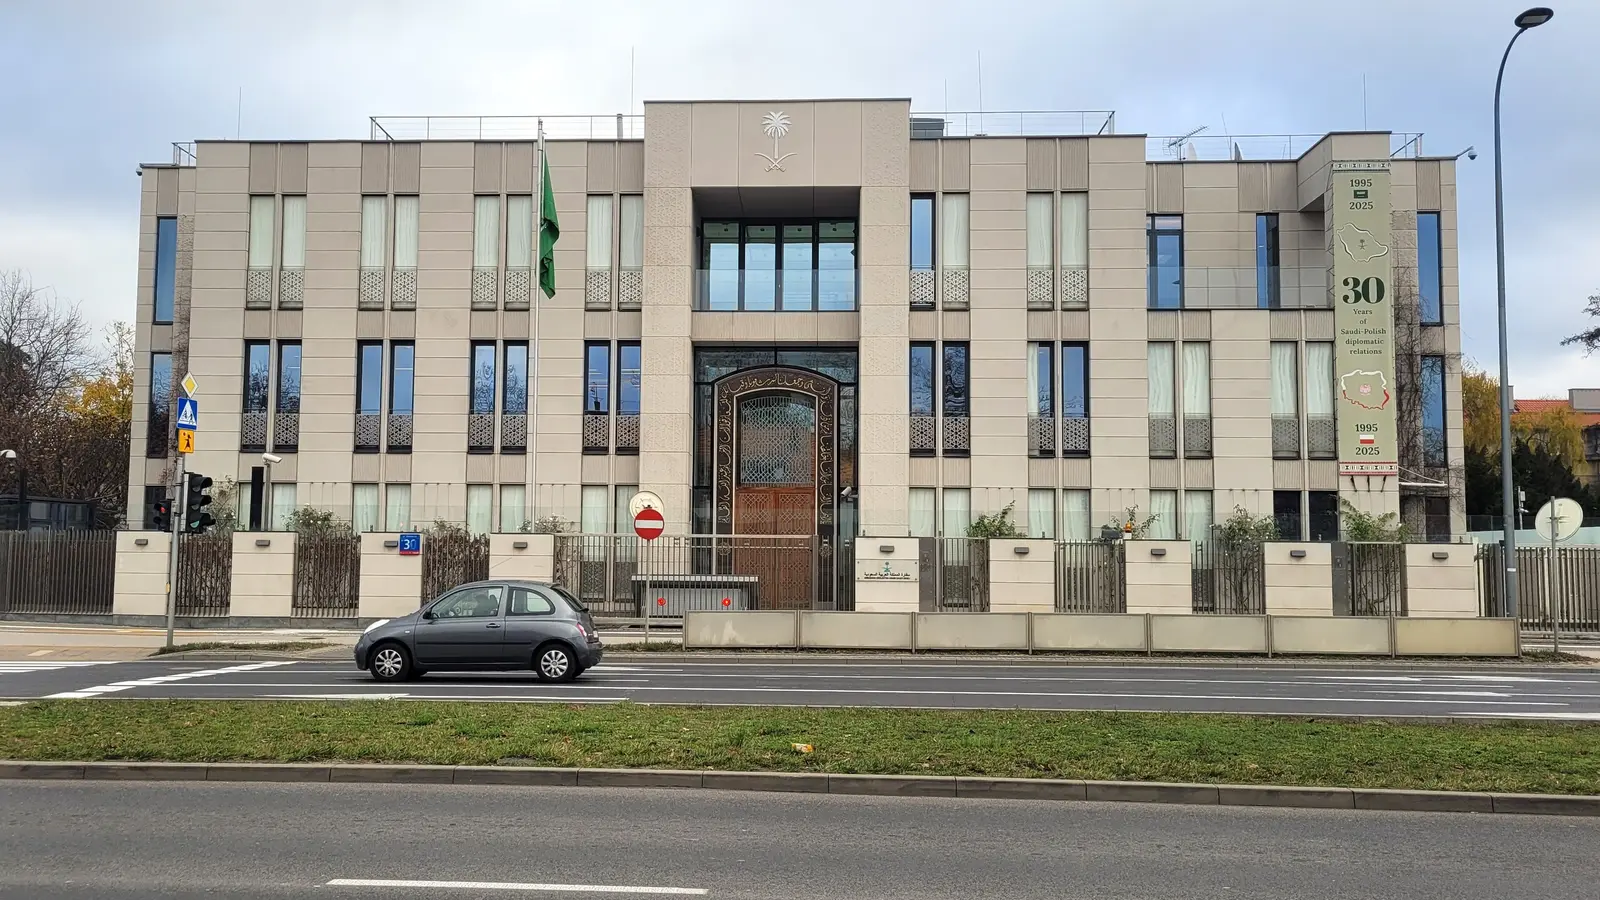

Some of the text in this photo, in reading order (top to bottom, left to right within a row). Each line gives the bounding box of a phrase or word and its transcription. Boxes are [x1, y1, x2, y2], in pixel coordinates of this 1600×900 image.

[1349, 178, 1373, 188] 1995
[1349, 201, 1374, 210] 2025
[1342, 276, 1385, 304] 30
[1345, 338, 1384, 346] diplomatic
[1355, 423, 1378, 432] 1995
[1355, 446, 1380, 456] 2025
